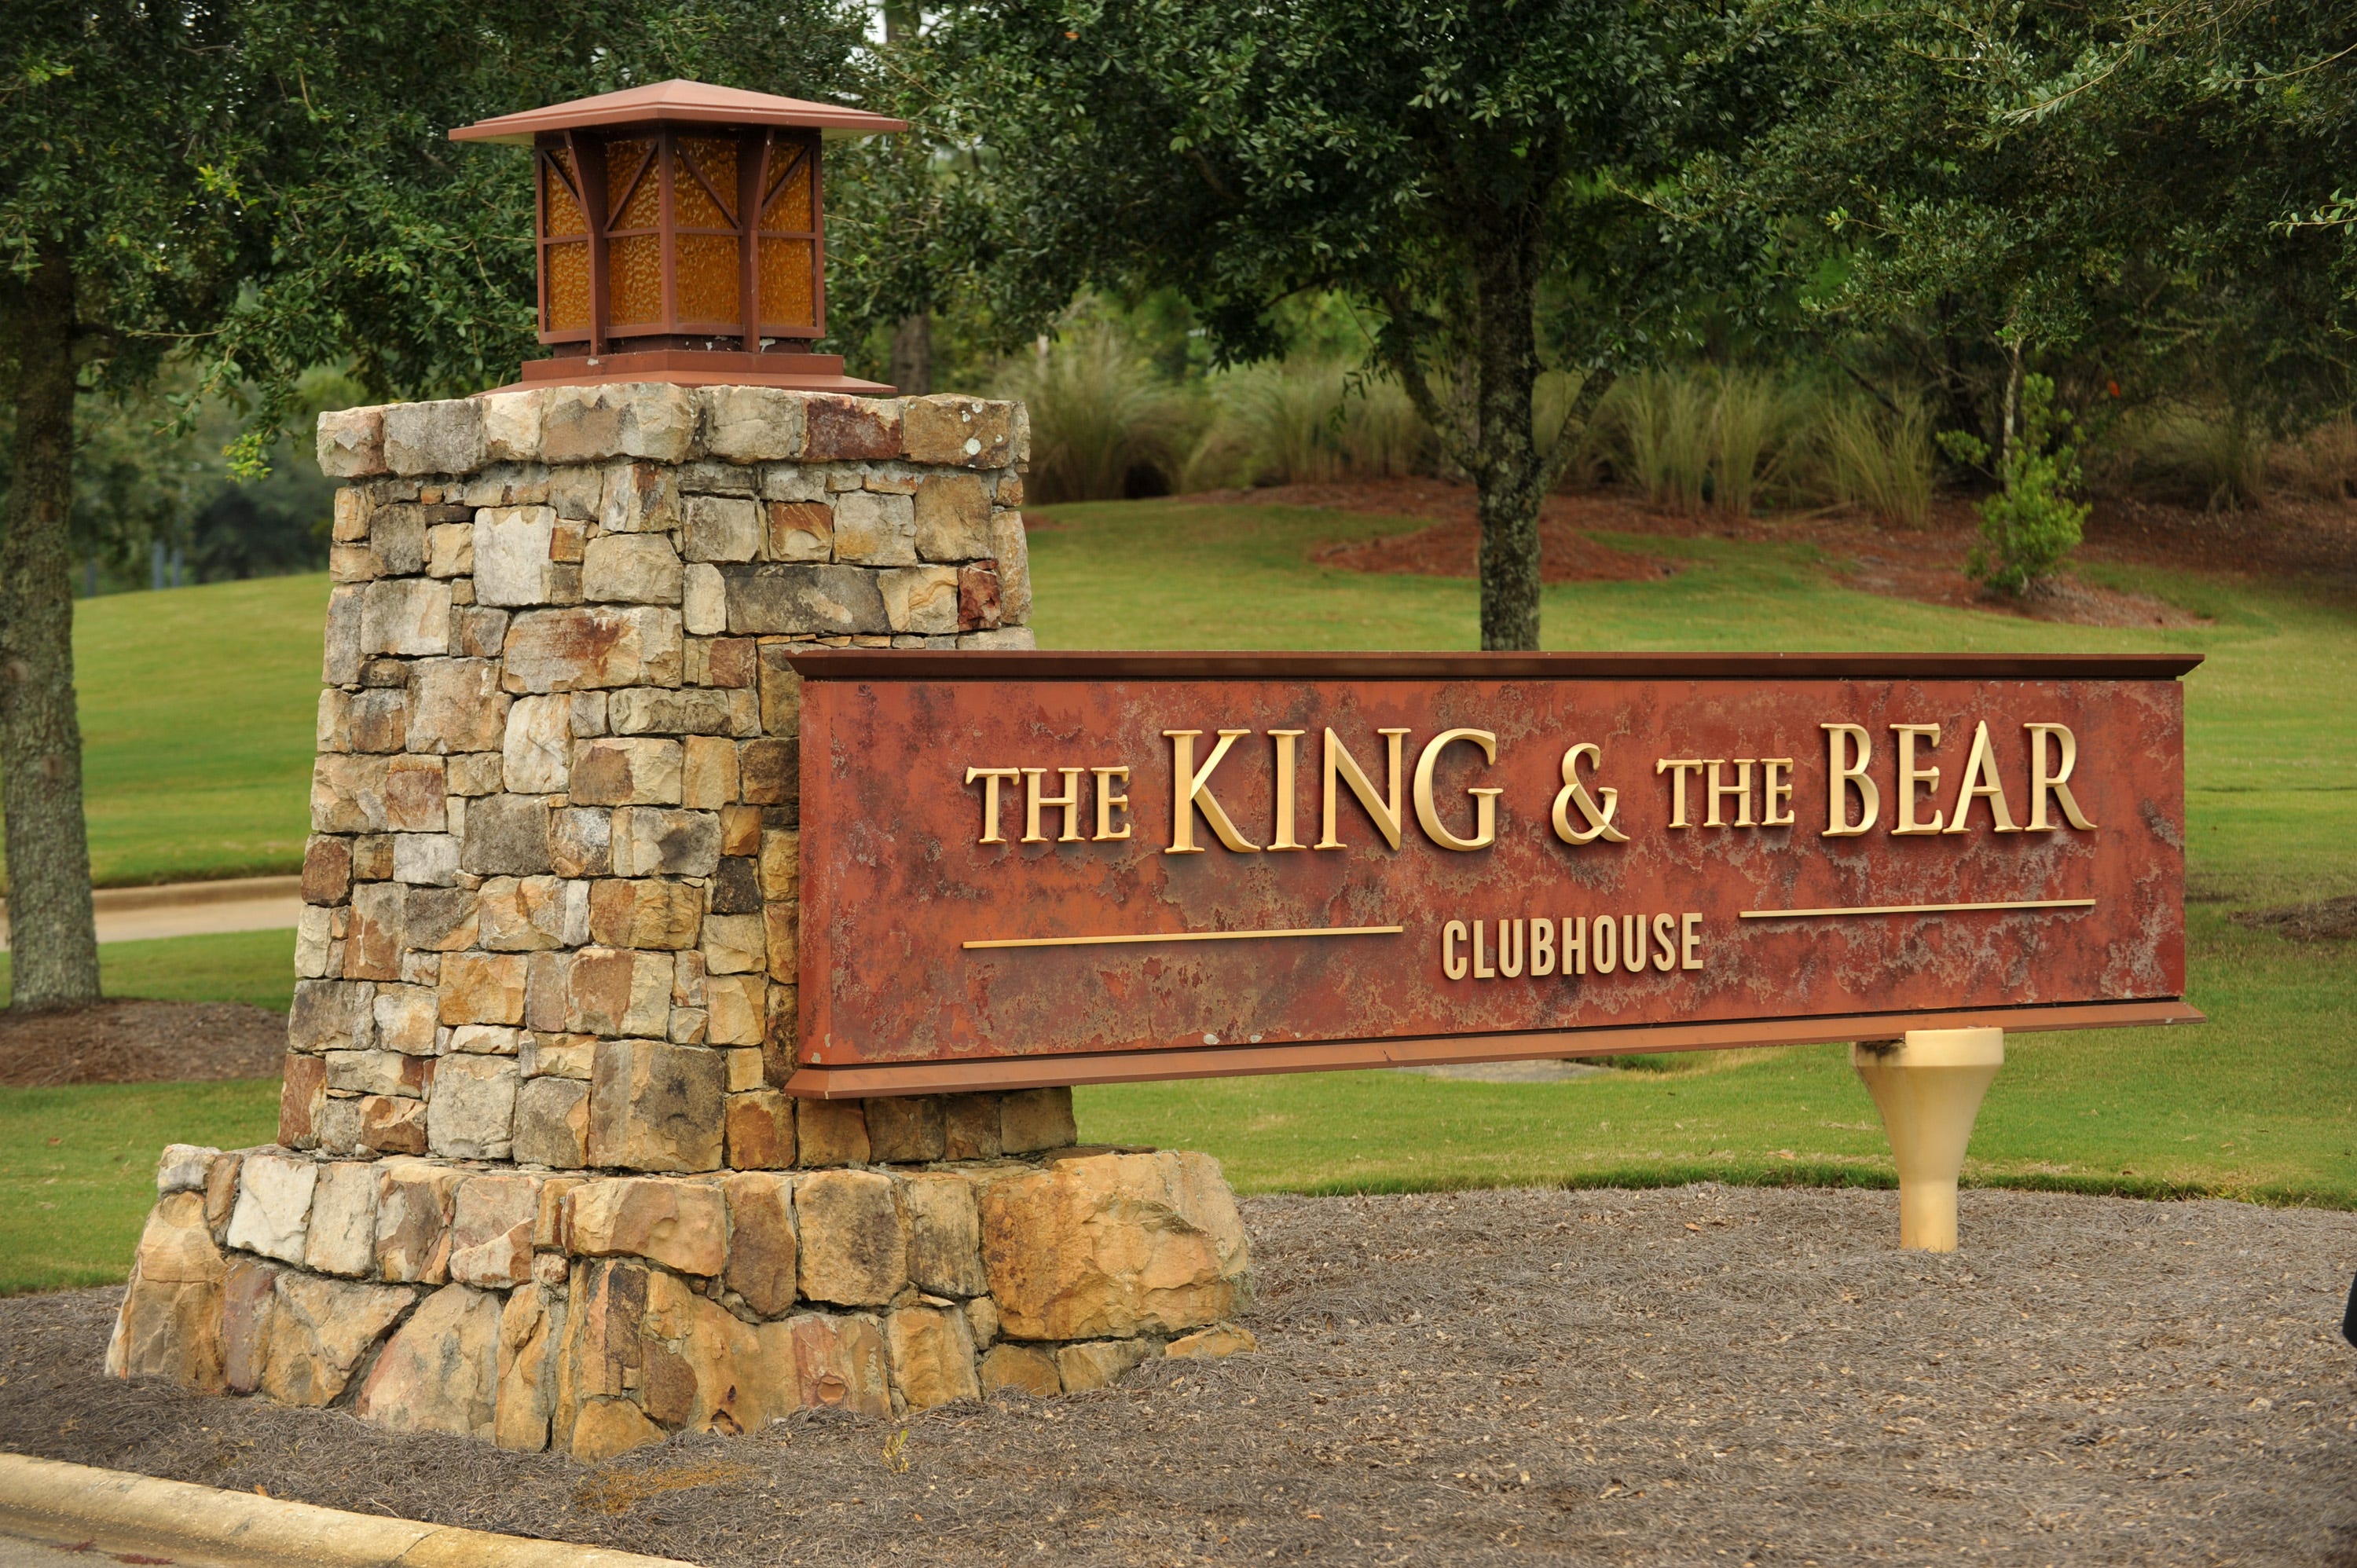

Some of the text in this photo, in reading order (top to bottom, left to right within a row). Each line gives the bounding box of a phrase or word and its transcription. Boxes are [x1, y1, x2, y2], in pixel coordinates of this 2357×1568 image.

[964, 720, 2099, 855] THE KING & THE BEAR
[1442, 911, 1705, 981] CLUBHOUSE
